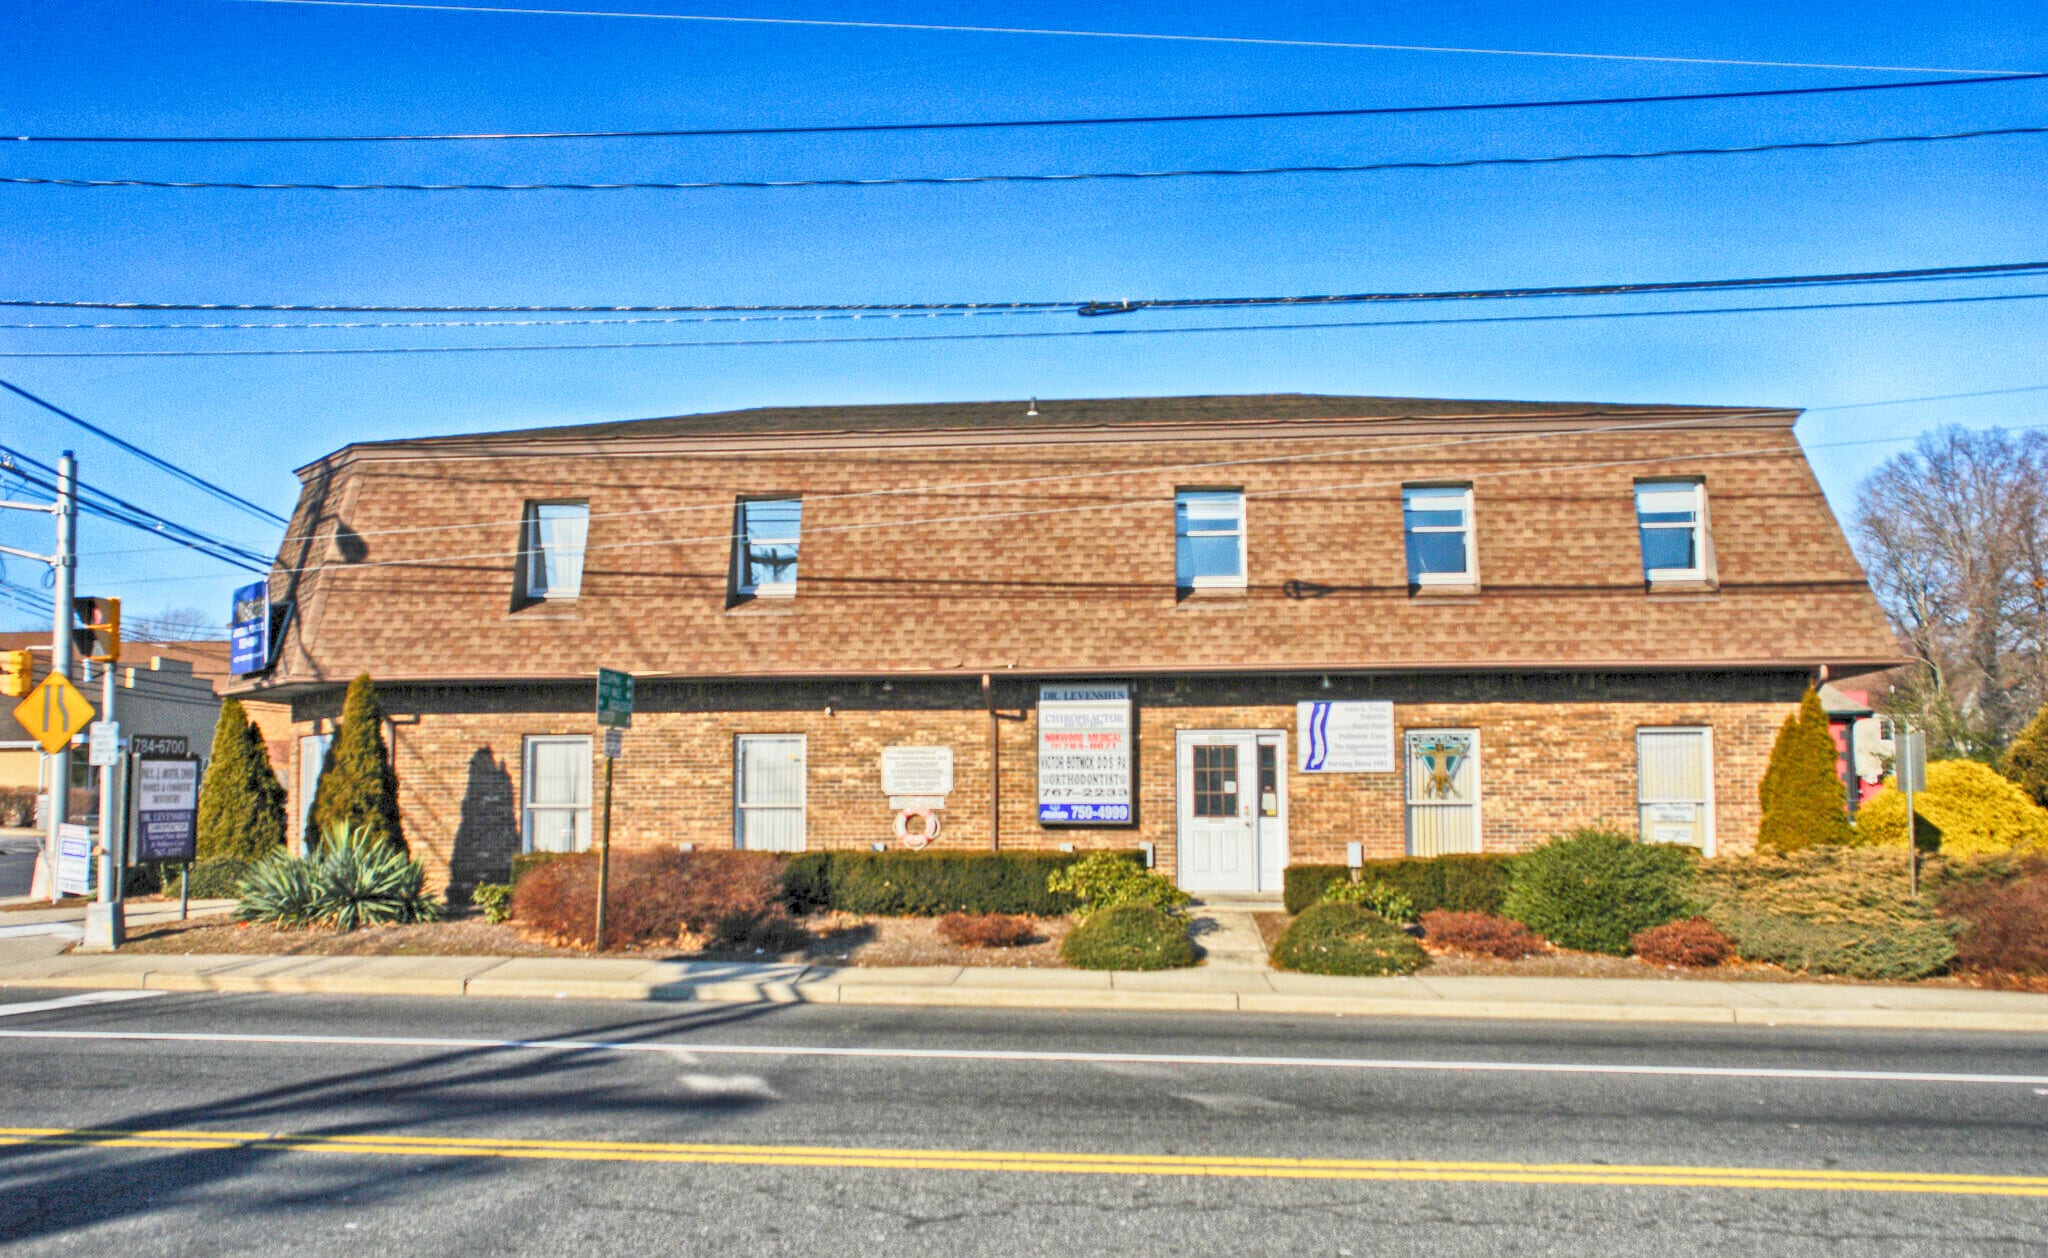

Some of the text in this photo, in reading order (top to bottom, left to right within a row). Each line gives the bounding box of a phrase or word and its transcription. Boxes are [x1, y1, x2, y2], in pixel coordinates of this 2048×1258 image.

[1045, 713, 1124, 723] CHIROPRACTOR
[1088, 733, 1122, 742] MEDICAL
[134, 739, 185, 753] 784-6700
[1049, 774, 1119, 785] ORTHODONTIST
[1042, 788, 1128, 798] 767-2233
